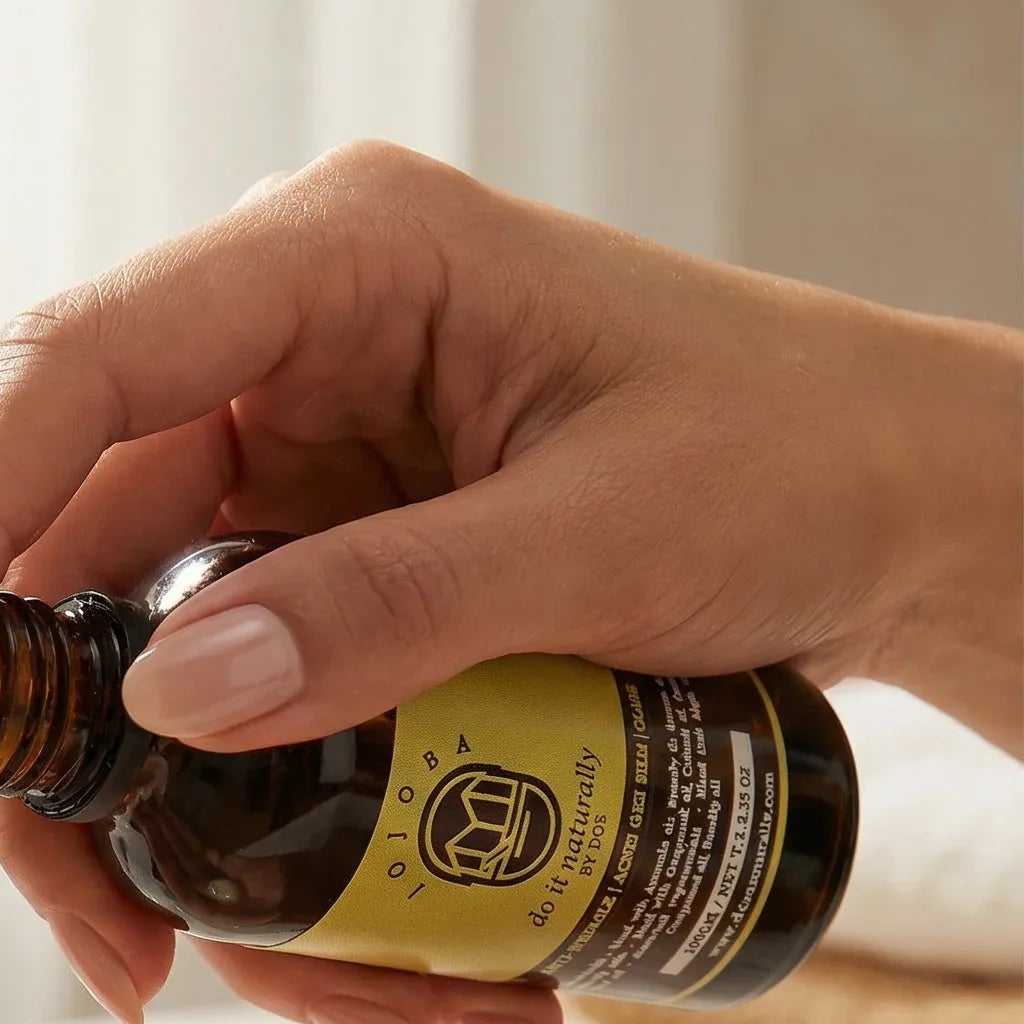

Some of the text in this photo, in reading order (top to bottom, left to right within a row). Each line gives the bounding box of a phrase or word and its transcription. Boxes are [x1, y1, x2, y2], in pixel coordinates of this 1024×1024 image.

[528, 747, 602, 927] do it naturally
[579, 814, 607, 876] BY DOS
[720, 862, 737, 897] NET
[739, 765, 750, 787] OZ
